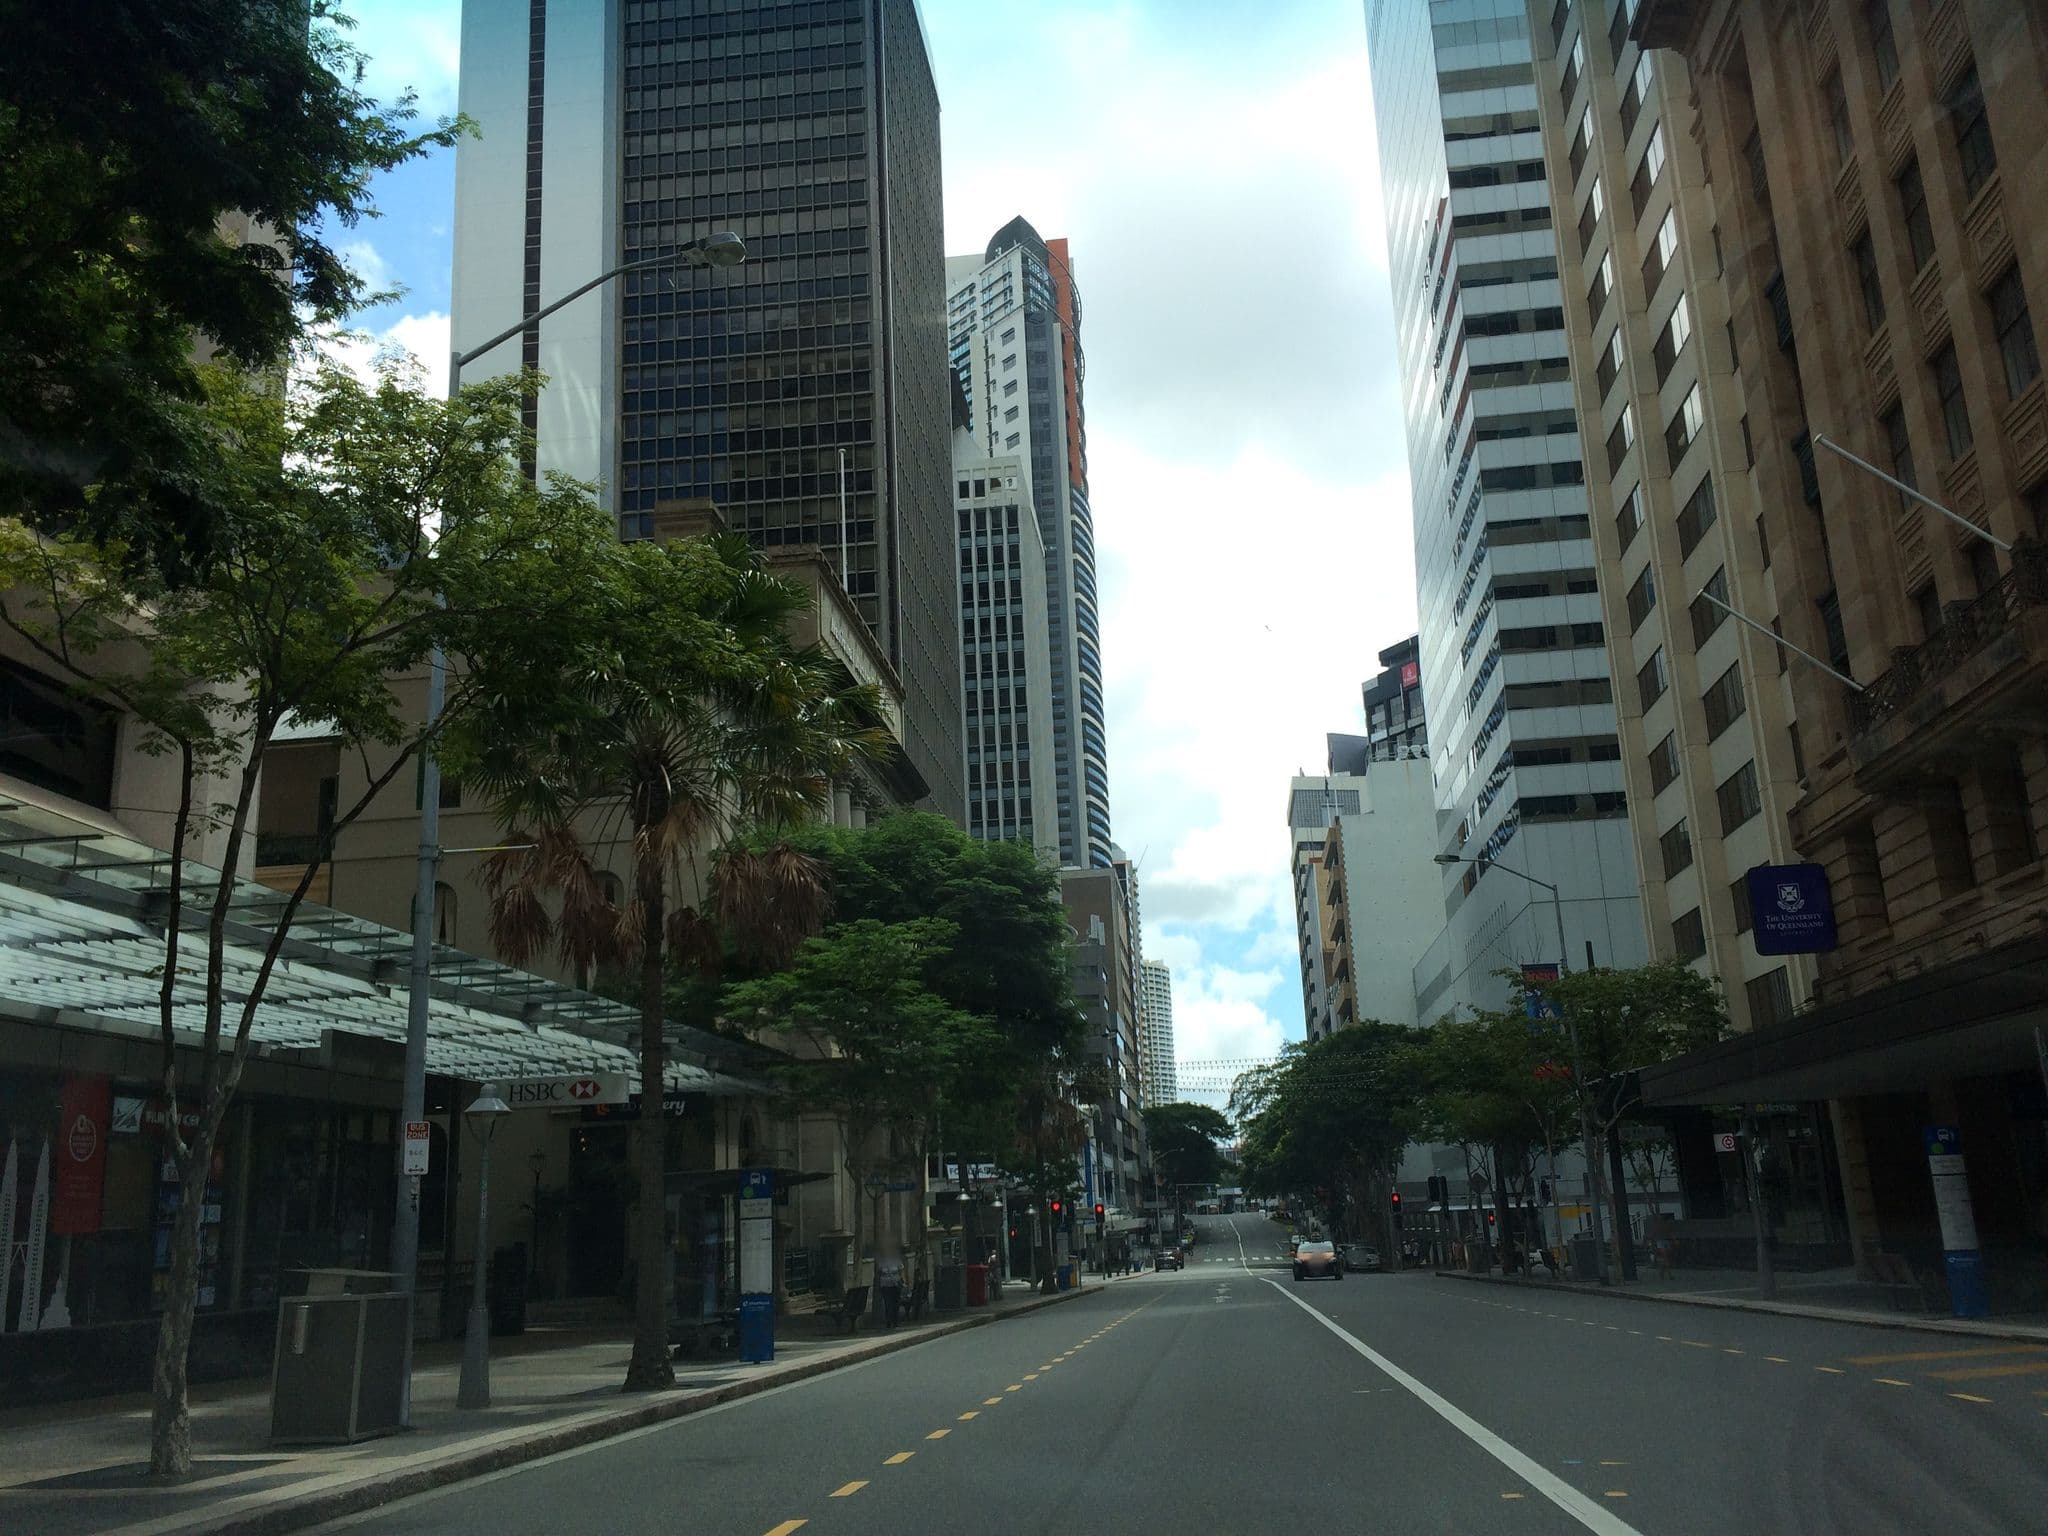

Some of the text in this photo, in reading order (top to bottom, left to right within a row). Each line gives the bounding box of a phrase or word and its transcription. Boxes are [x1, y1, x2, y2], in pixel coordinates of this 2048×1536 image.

[1781, 913, 1823, 922] UNIVERSITY
[1778, 921, 1824, 930] QUEENSLAND
[510, 1082, 565, 1101] HSBC
[408, 1122, 426, 1131] BUS
[407, 1131, 427, 1139] ZONE
